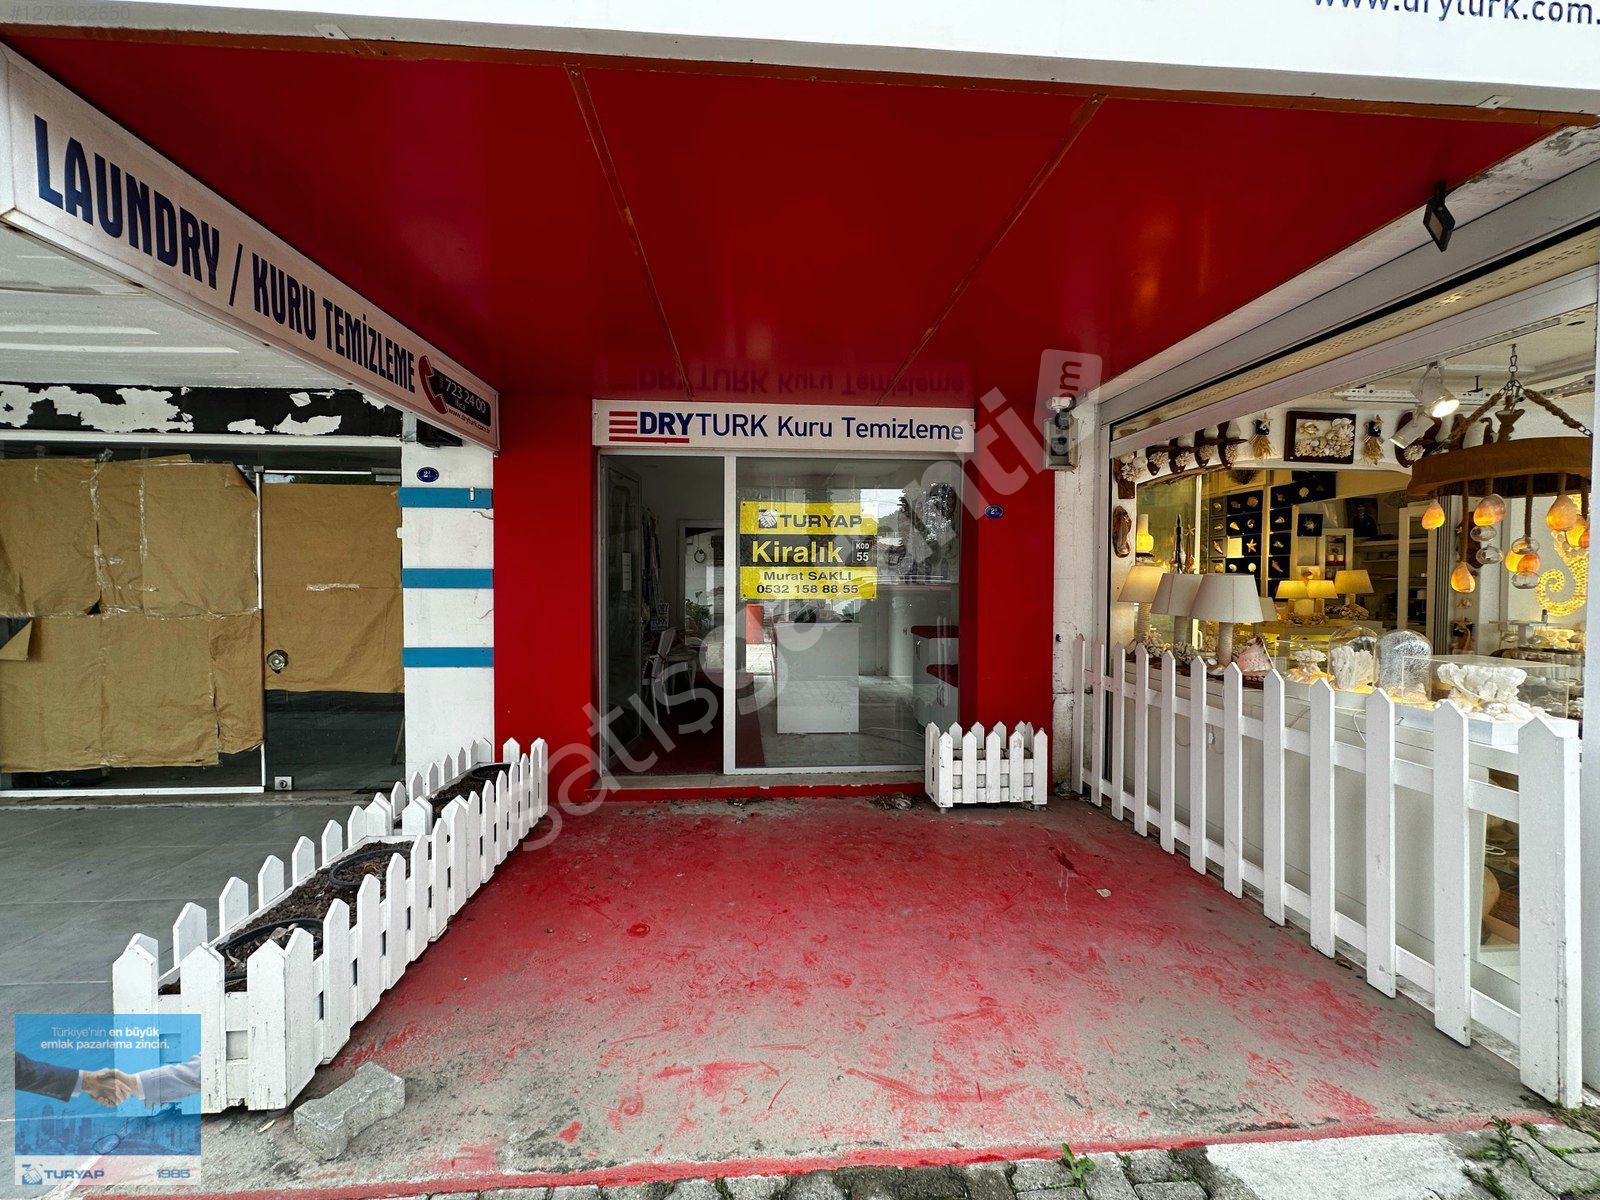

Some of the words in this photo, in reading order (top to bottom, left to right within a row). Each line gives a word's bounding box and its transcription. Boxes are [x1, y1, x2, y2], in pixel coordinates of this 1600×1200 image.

[1314, 0, 1600, 25] .ryturk.com.
[34, 114, 220, 290] LAUNDRY
[228, 243, 244, 307] /
[252, 252, 316, 341] KURU
[322, 297, 416, 394] TEMİZLEME
[445, 378, 463, 399] 723
[464, 390, 475, 407] 24
[475, 398, 487, 414] 00
[777, 415, 833, 438] Kuru
[841, 416, 964, 440] Temizleme
[780, 514, 863, 528] TURYAP
[752, 540, 844, 563] Kiralık
[855, 542, 870, 550] KOD
[856, 552, 869, 562] 55
[763, 571, 804, 581] Murat
[808, 571, 852, 581] SAKLI
[756, 585, 790, 594] 0532
[795, 585, 818, 594] 158
[822, 585, 838, 594] 88
[842, 585, 859, 594] 55
